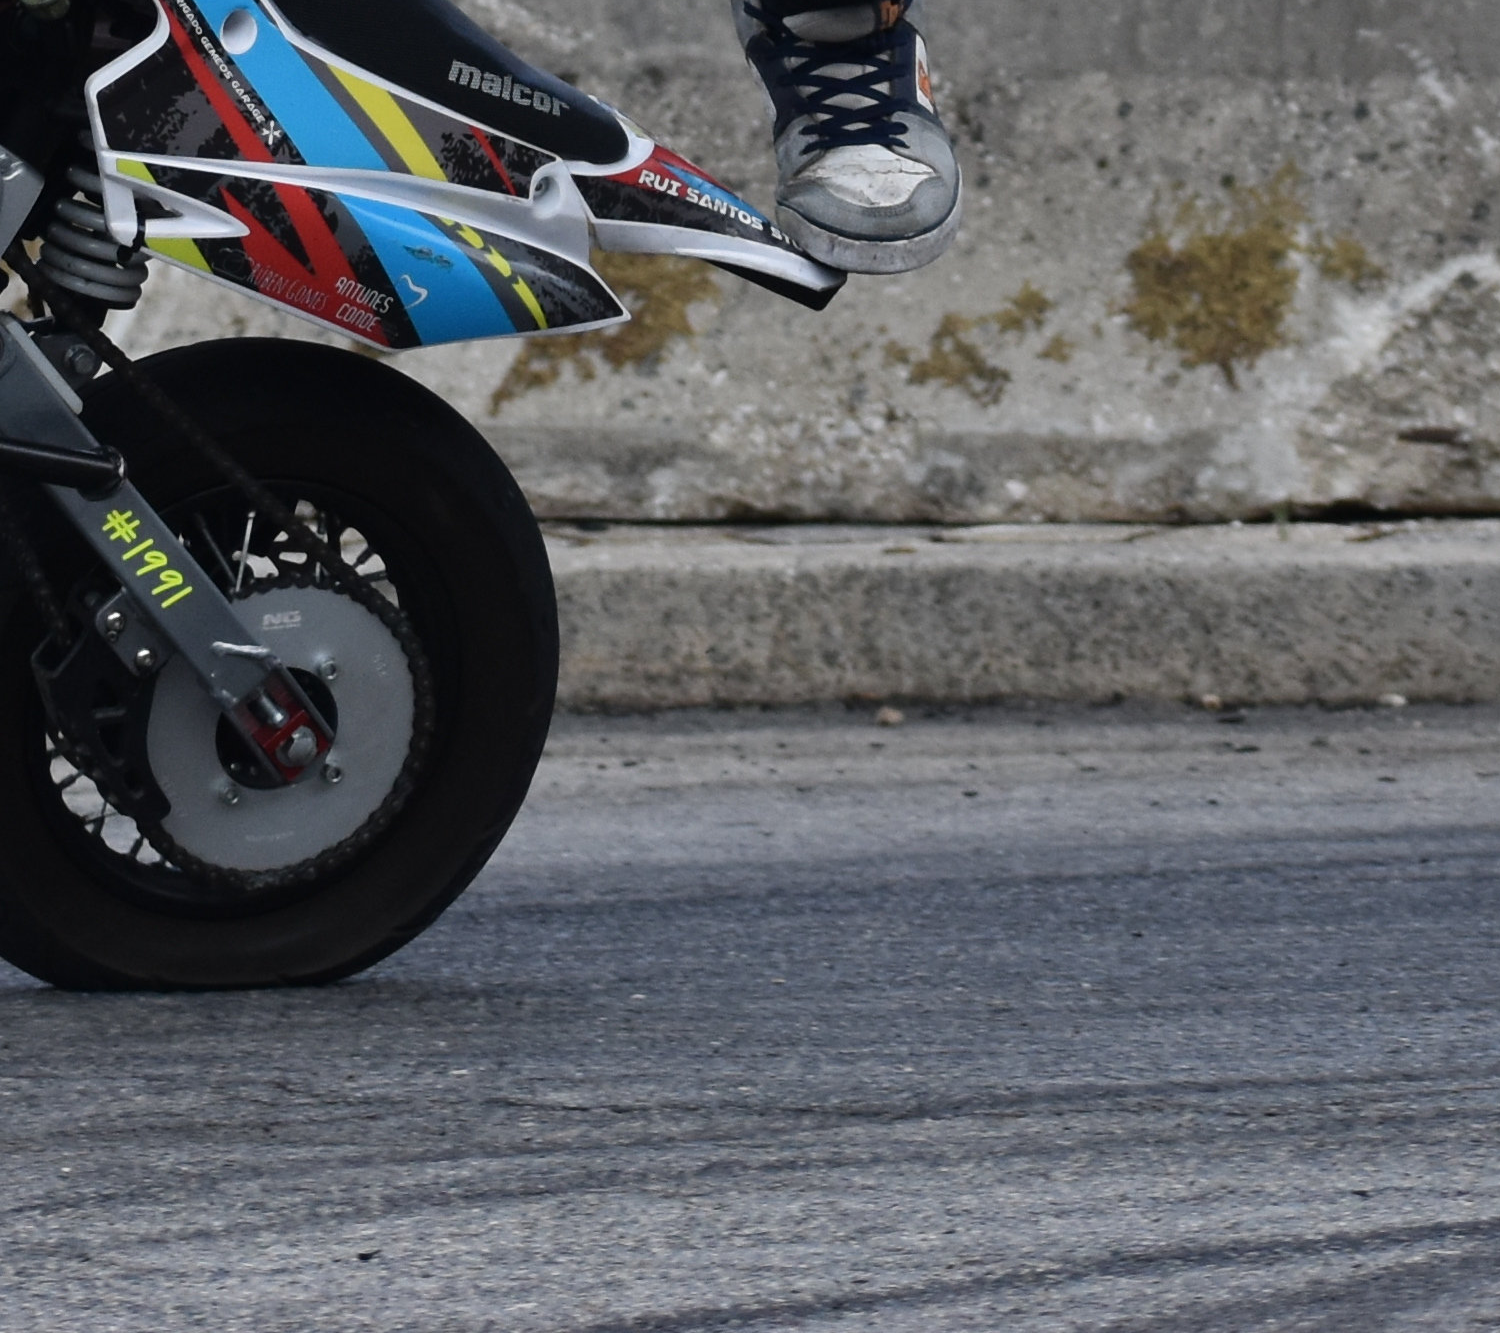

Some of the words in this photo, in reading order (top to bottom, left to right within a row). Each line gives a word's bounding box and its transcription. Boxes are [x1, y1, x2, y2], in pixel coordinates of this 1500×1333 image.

[200, 36, 234, 80] GEMEOS
[231, 80, 266, 124] GARAGE
[448, 60, 570, 117] malcor
[638, 169, 682, 197] RUI
[685, 187, 763, 231] SANTOS
[335, 276, 394, 314] ANTUNES
[335, 302, 382, 333] CONDE
[102, 509, 193, 609] #1991
